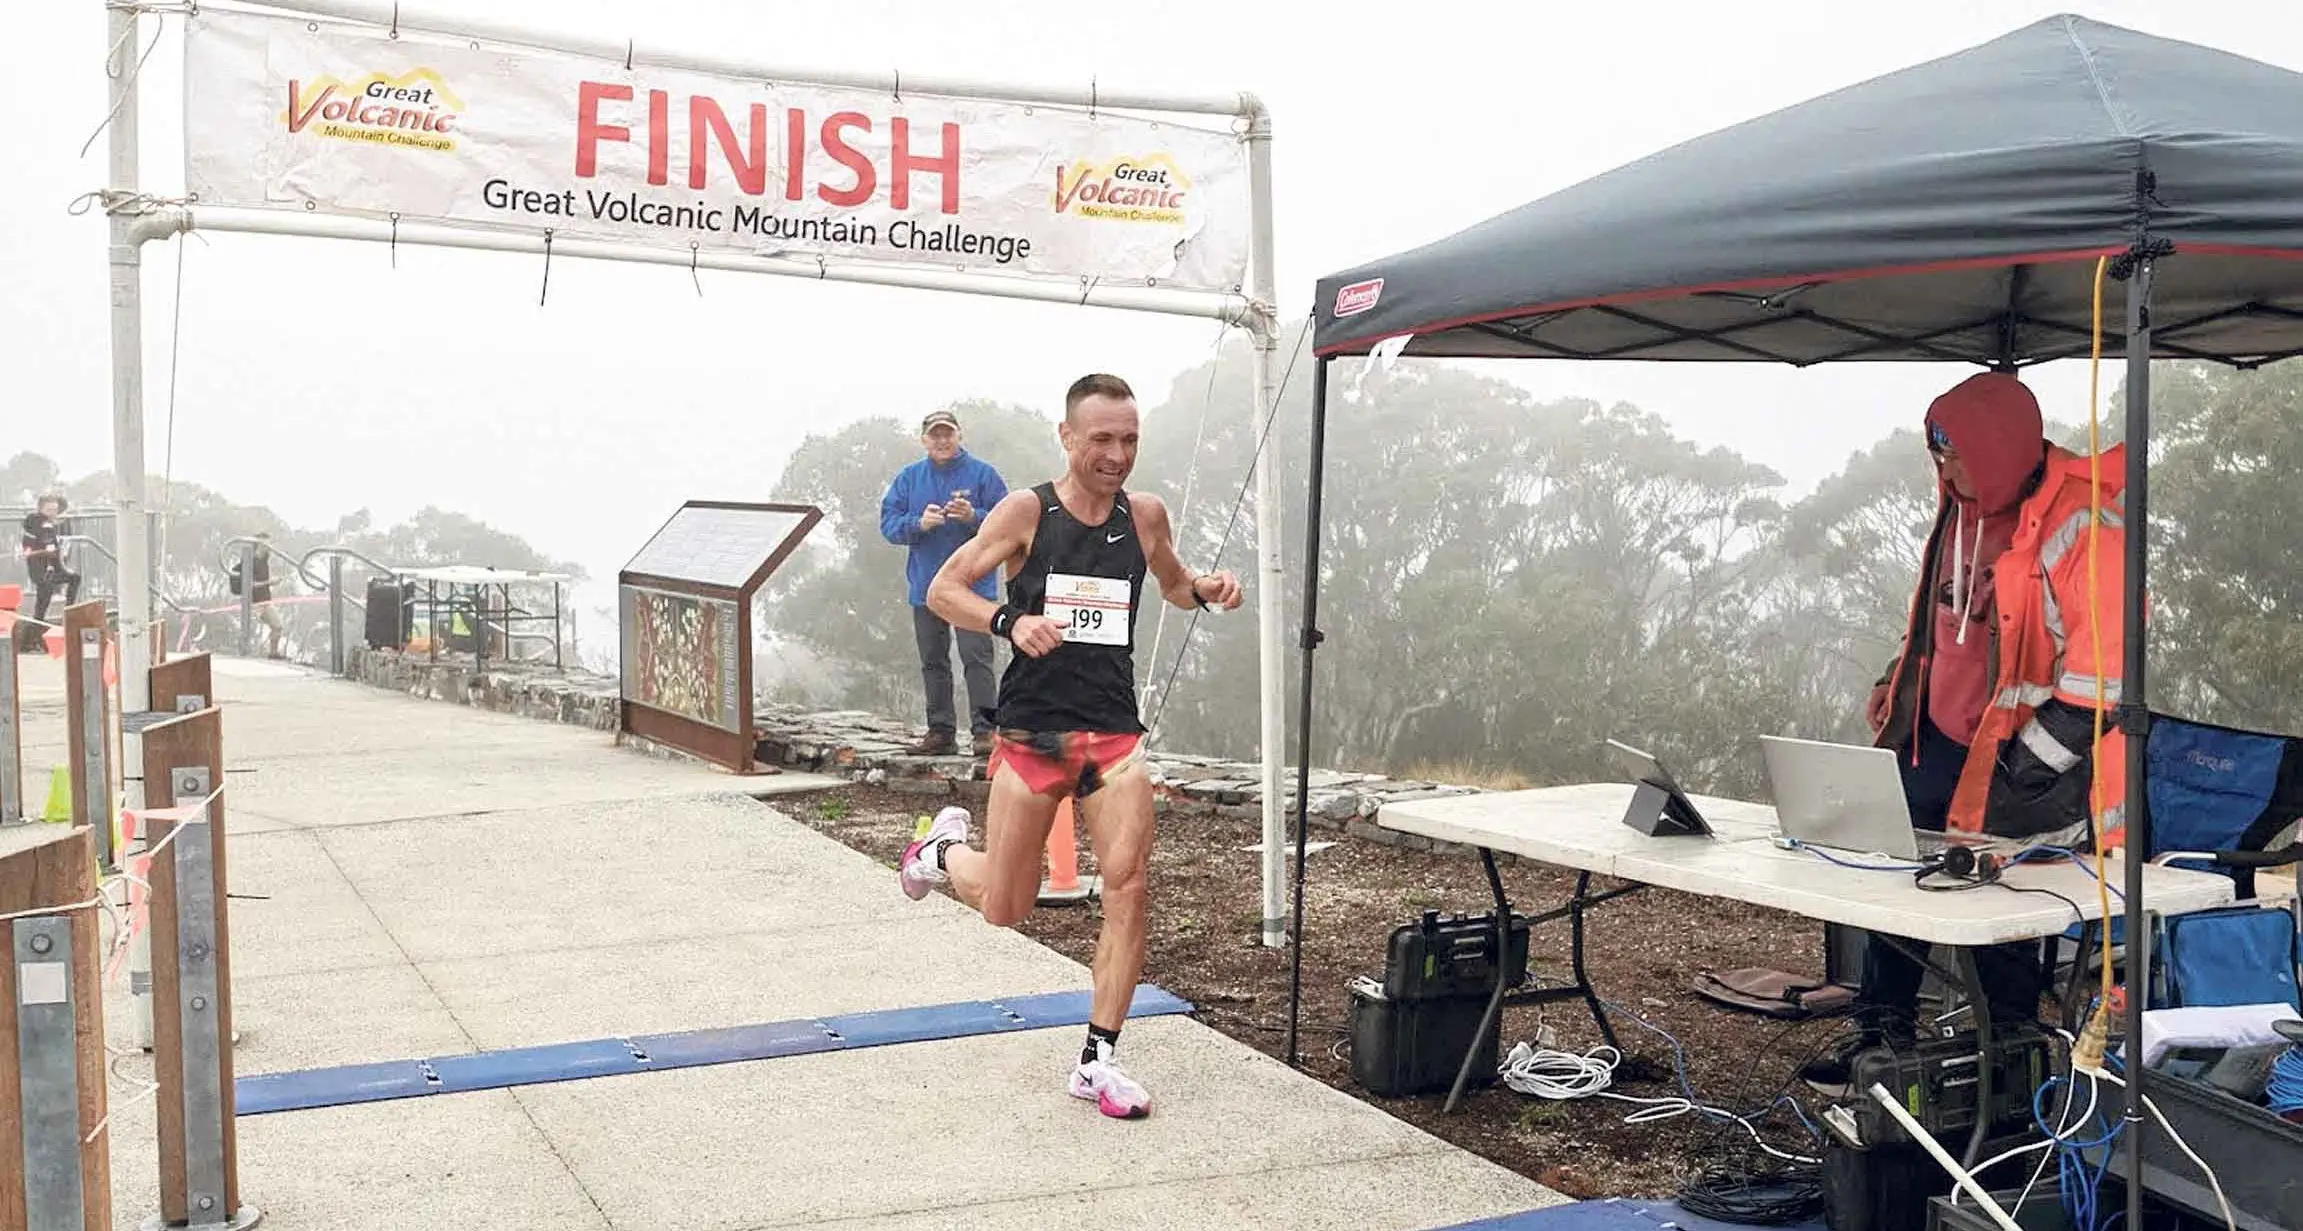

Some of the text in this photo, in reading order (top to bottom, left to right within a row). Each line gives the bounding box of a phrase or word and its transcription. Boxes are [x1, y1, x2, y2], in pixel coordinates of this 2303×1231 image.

[288, 79, 457, 133] Volcanic
[366, 81, 434, 104] Great
[324, 125, 385, 143] Mountain
[575, 80, 960, 215] FINISH
[1055, 164, 1186, 214] Volcanic
[1115, 162, 1169, 184] Great
[483, 179, 1031, 264] Great Volcanic Mountain Challenge
[1071, 608, 1103, 629] 199
